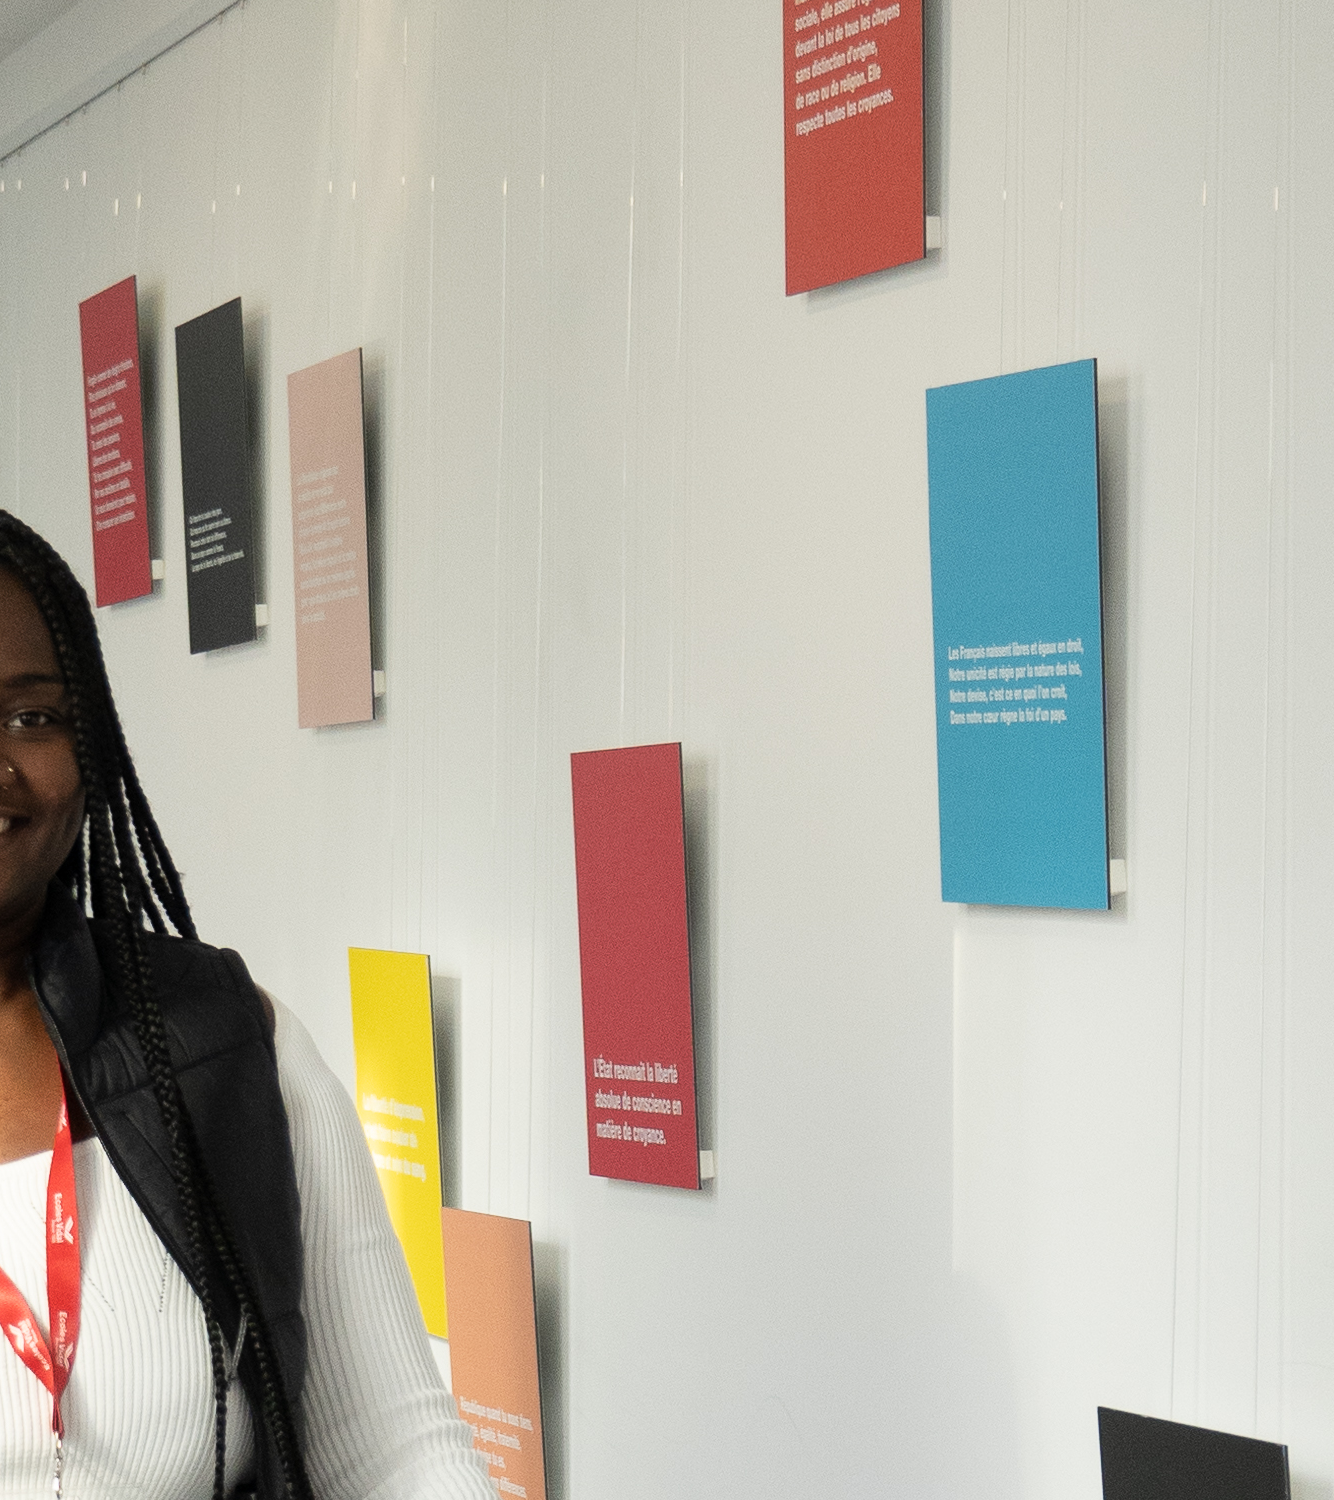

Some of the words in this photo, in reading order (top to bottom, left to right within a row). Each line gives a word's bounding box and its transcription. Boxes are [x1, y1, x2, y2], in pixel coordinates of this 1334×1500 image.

[795, 8, 820, 32] sociale,
[821, 1, 834, 21] elle
[795, 34, 818, 58] devant
[825, 26, 835, 45] loi
[835, 24, 844, 42] de
[844, 19, 860, 37] tous
[860, 14, 871, 30] les
[871, 3, 900, 27] citoyens
[593, 1053, 613, 1079] L'État
[646, 1062, 654, 1082] la
[655, 1062, 678, 1084] liberté
[595, 1088, 622, 1109] absolue
[622, 1090, 632, 1111] de
[632, 1093, 672, 1114] conscience
[672, 1099, 682, 1115] en
[596, 1119, 622, 1140] matière
[622, 1121, 632, 1141] de
[632, 1126, 666, 1146] croyance.
